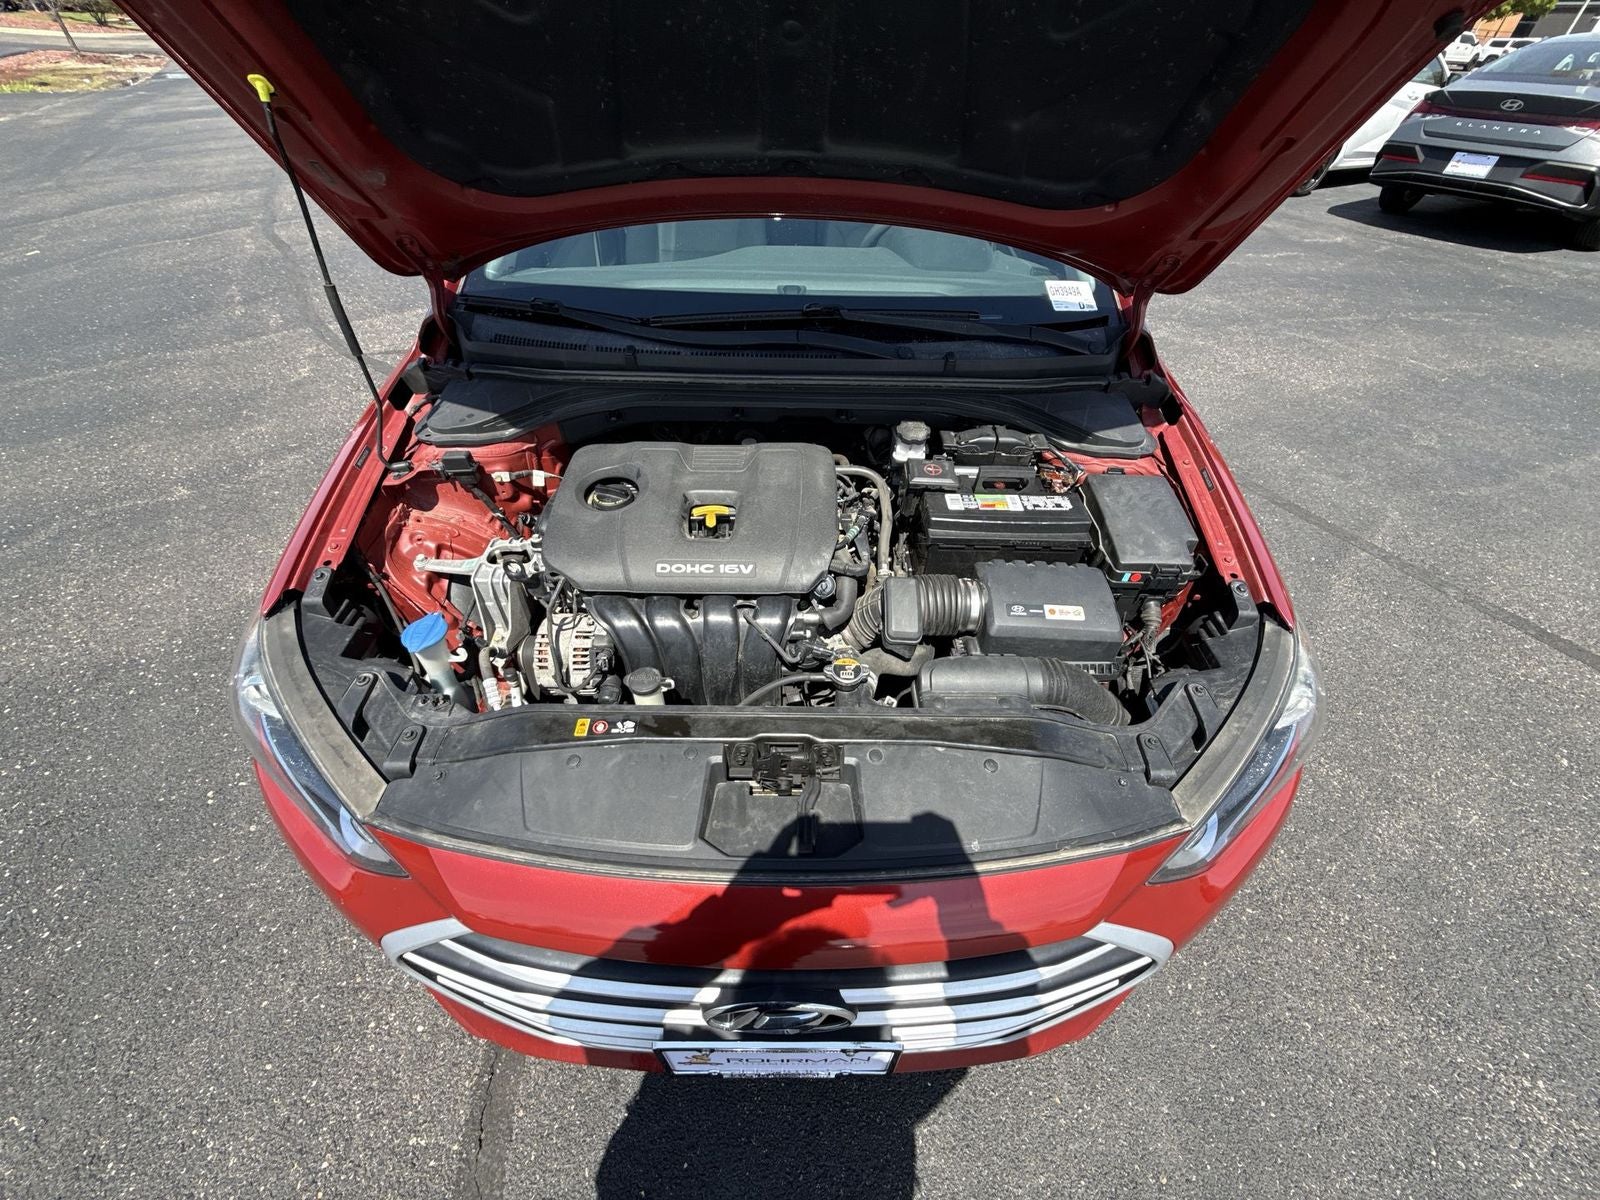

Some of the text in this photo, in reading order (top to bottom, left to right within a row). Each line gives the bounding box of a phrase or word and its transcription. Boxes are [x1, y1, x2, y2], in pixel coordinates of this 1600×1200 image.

[1456, 121, 1541, 135] ELANTRA
[656, 563, 754, 574] DOHC 16V
